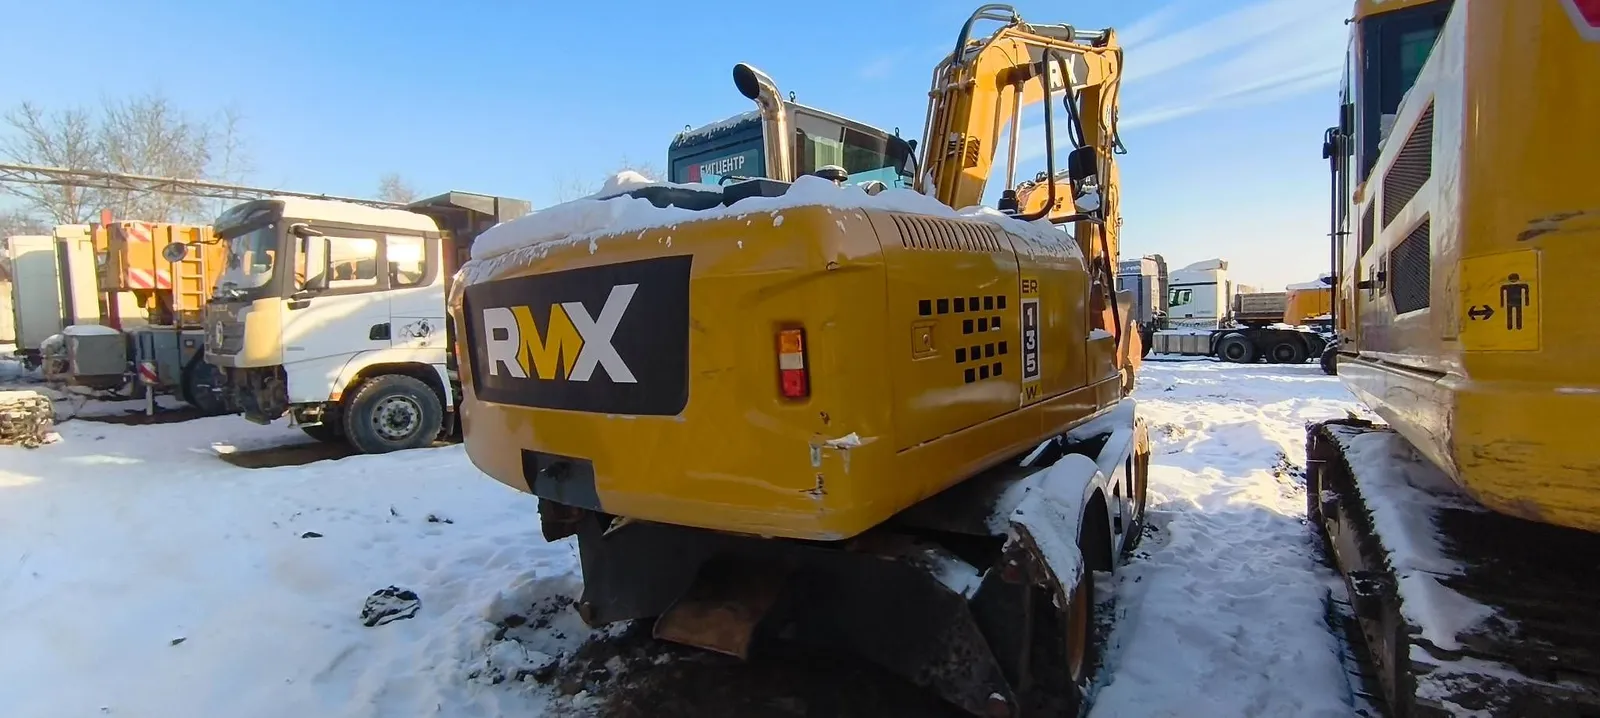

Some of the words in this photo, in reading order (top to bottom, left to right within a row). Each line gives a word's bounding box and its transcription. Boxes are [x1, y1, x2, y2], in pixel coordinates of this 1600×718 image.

[1049, 54, 1077, 88] RX
[1022, 280, 1038, 293] ER
[483, 283, 640, 383] RMX
[1026, 385, 1037, 400] W
